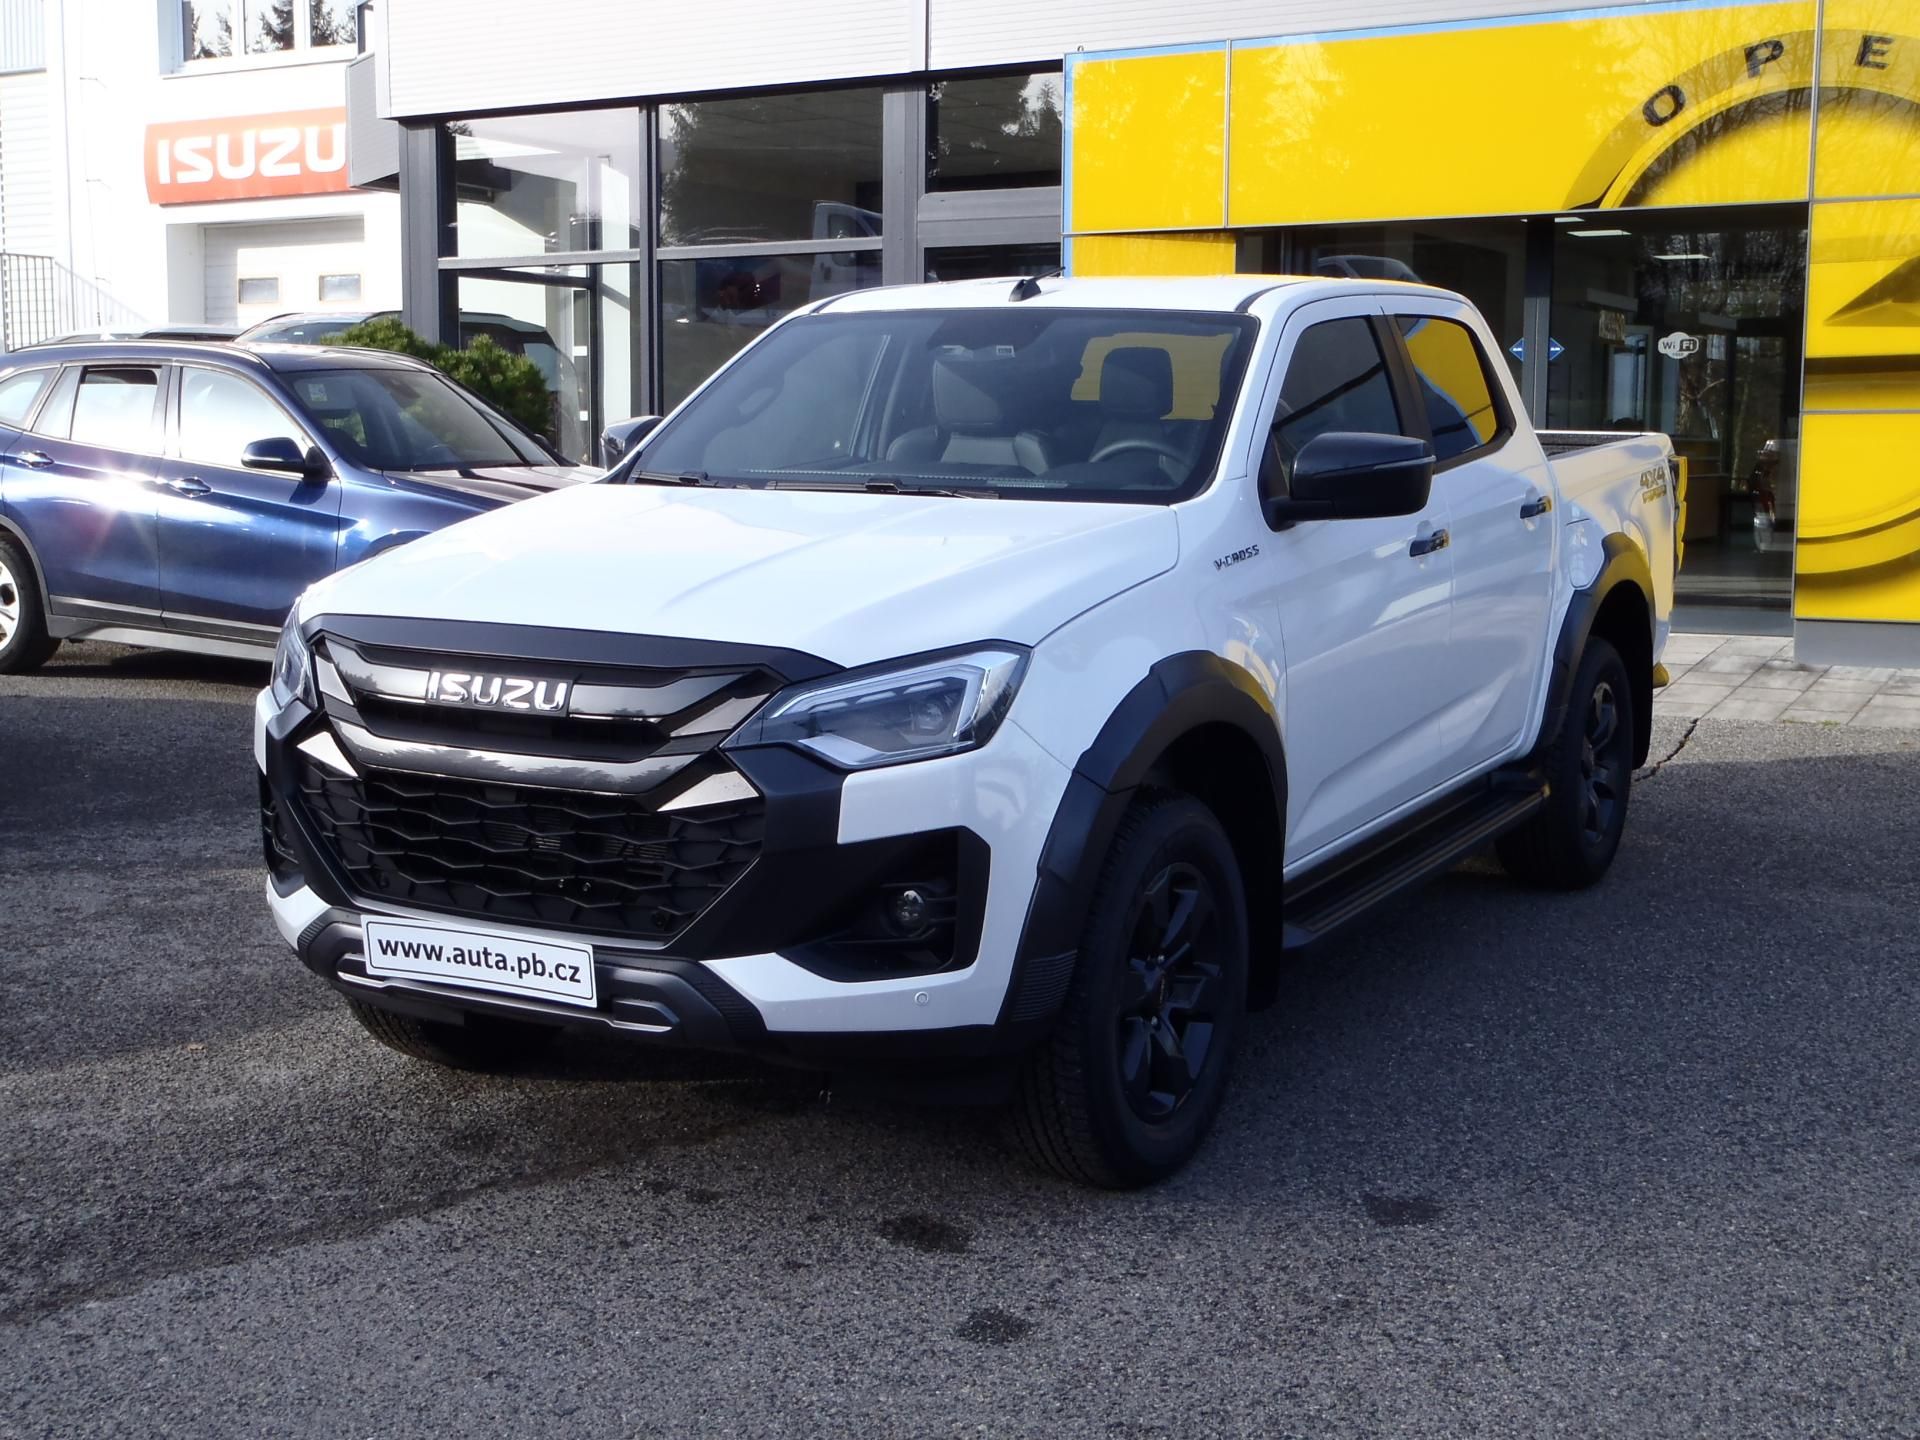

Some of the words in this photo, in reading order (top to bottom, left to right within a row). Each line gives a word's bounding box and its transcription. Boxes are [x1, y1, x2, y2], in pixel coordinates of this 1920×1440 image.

[157, 123, 346, 184] ISUZU
[428, 671, 568, 711] ISUZU
[378, 938, 582, 984] www.auta.pb.cz
